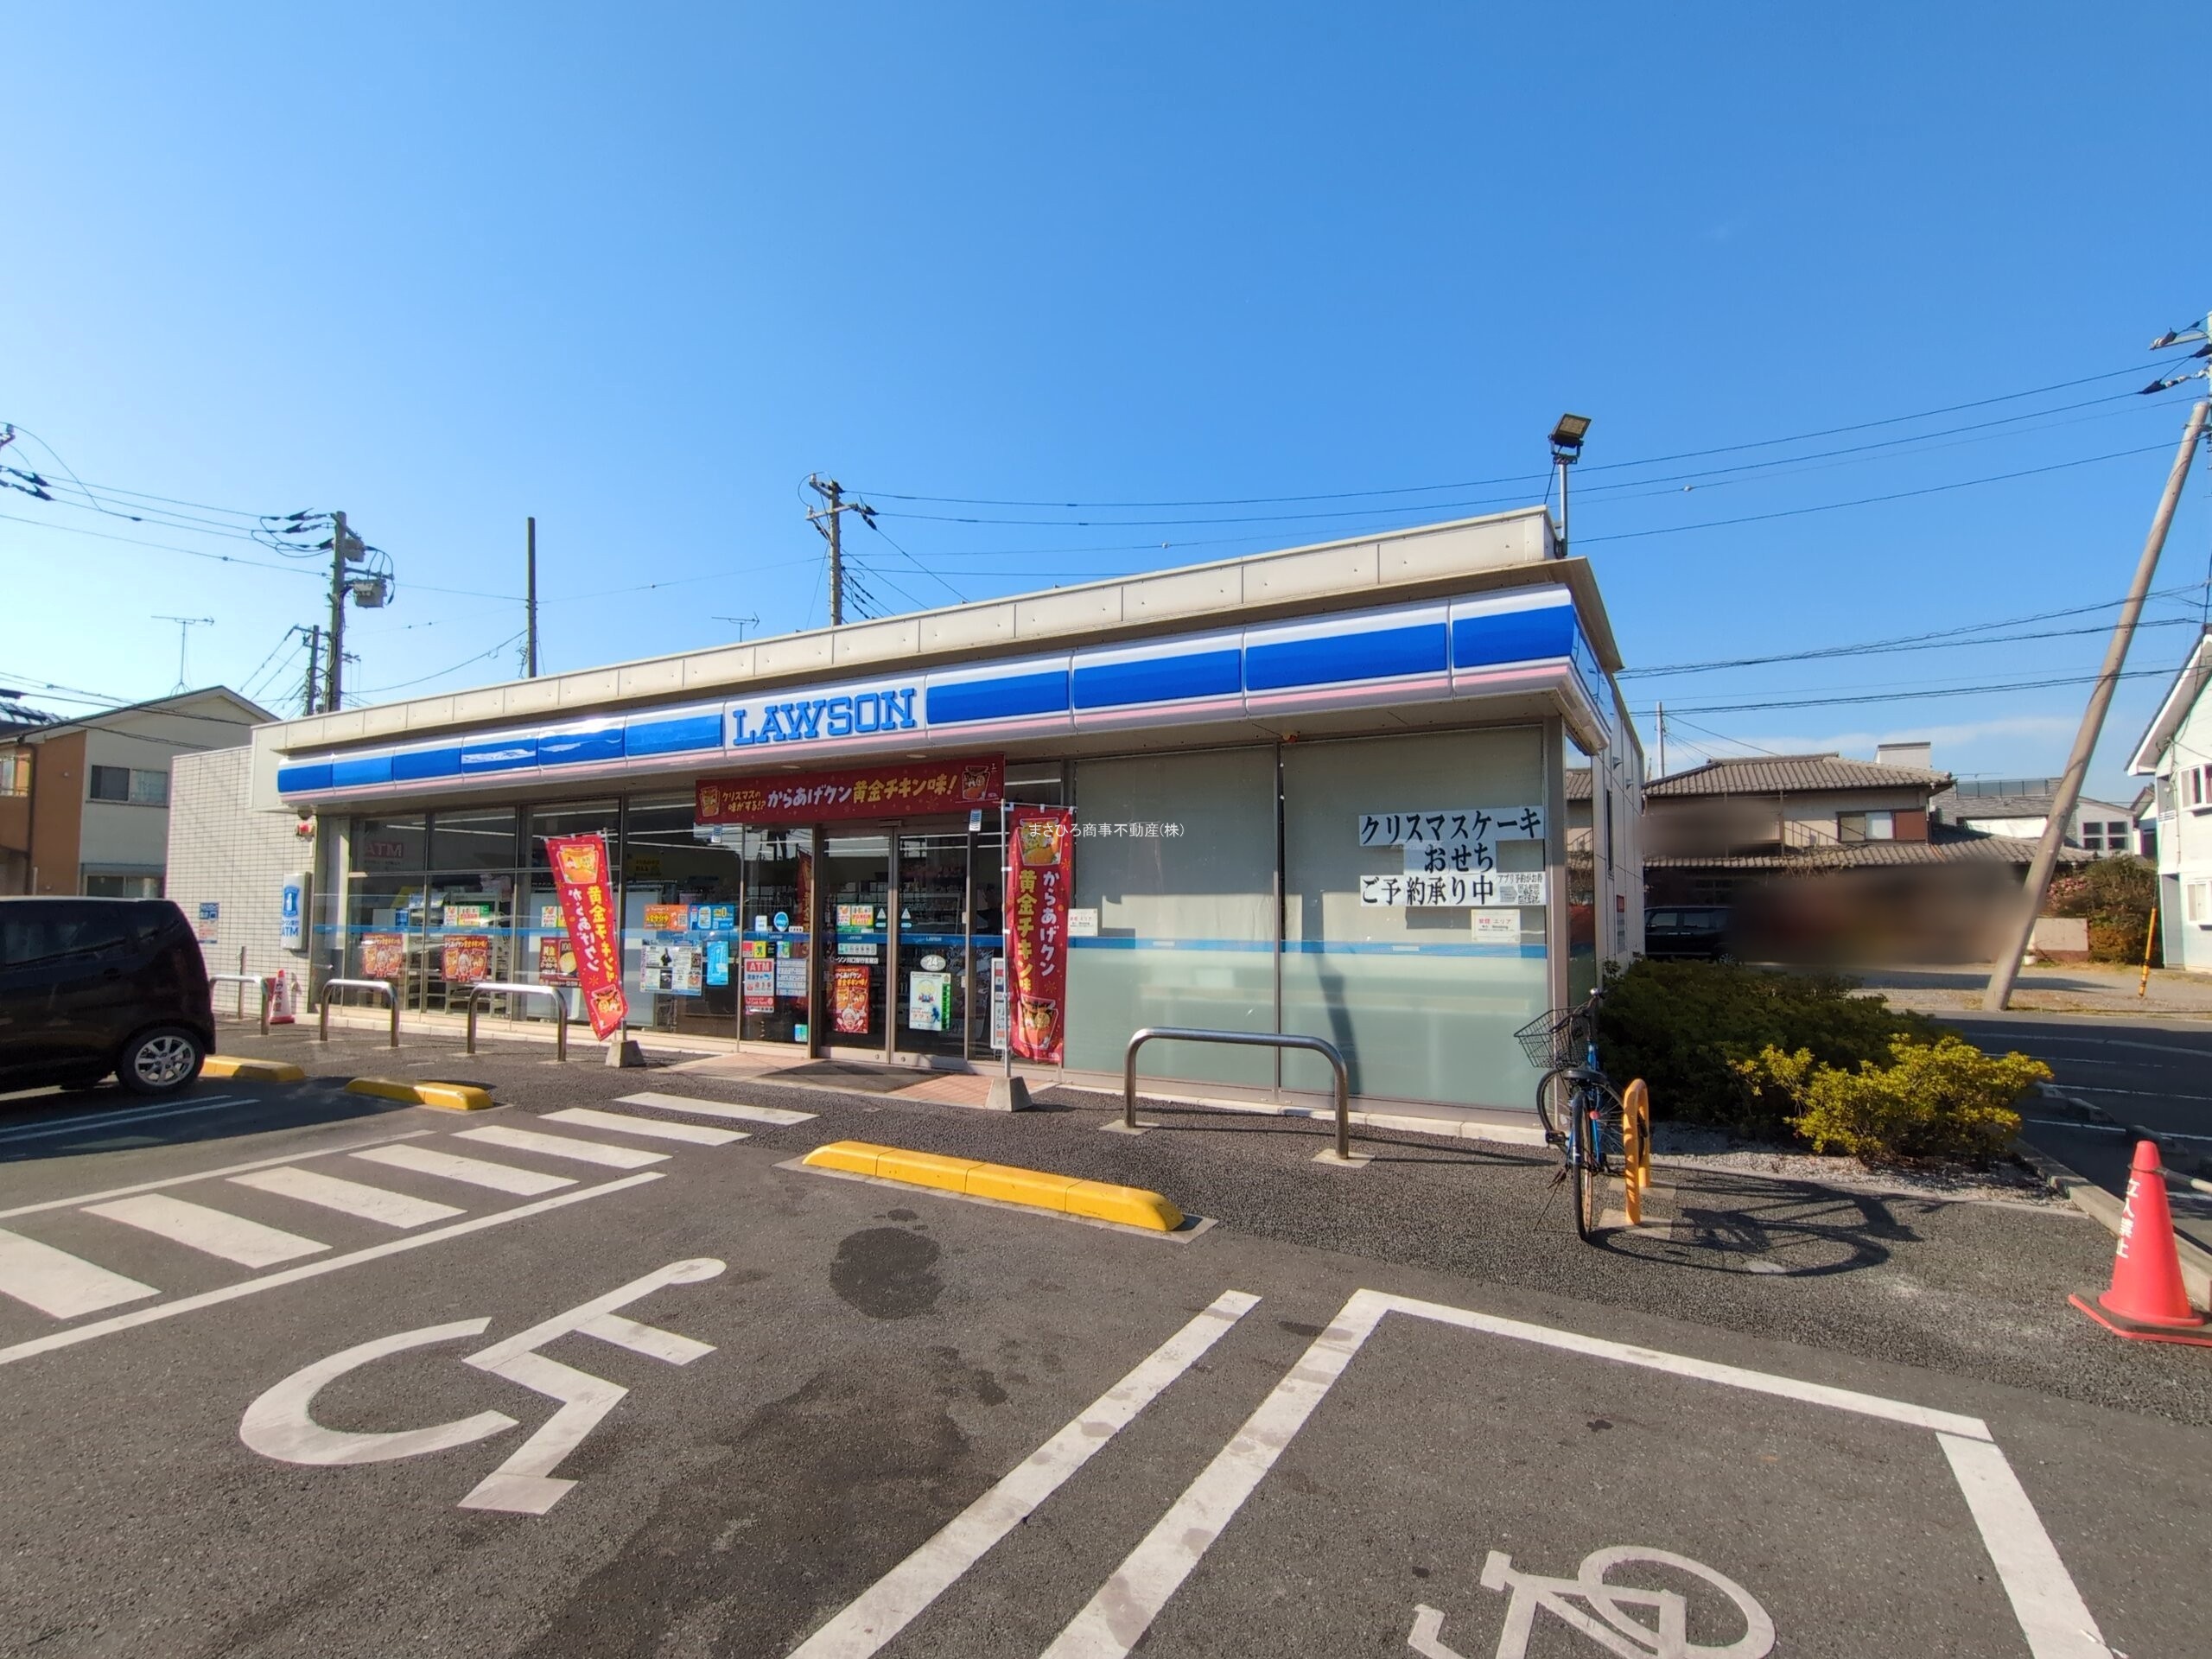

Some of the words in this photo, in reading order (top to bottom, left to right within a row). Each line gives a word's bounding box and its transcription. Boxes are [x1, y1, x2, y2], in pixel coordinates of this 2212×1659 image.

[733, 688, 918, 746] LAWSON
[722, 791, 761, 802] クリスマスの
[1361, 808, 1541, 844] クリスマスケーキ
[1425, 842, 1493, 873] おせち
[1363, 874, 1493, 906] ご予約承り中
[281, 926, 299, 937] ATM
[1016, 869, 1038, 993] 黄金チキン味
[1040, 870, 1060, 977] からあげクン
[749, 962, 770, 971] ATM
[927, 957, 938, 965] 24
